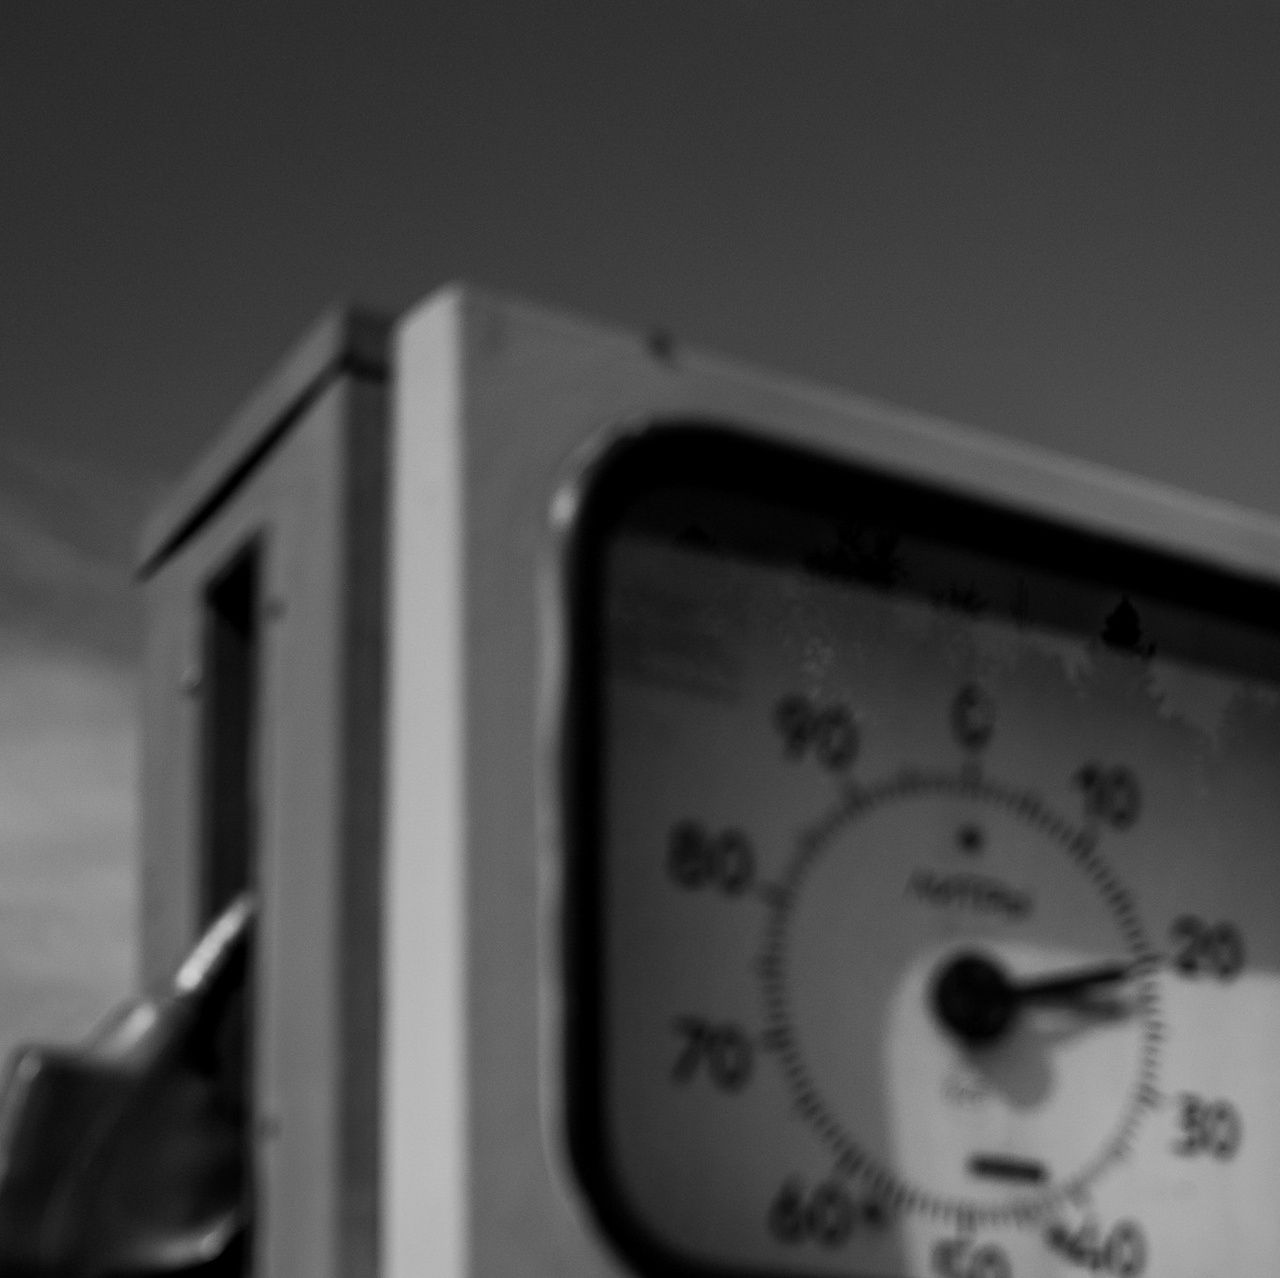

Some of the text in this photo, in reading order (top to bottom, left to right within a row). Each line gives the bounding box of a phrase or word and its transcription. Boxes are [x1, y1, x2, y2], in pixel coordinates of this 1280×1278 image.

[774, 692, 859, 773] 90
[1075, 762, 1142, 830] 10
[668, 820, 754, 897] 80
[1168, 914, 1246, 983] 20
[671, 1014, 754, 1094] 70
[1172, 1092, 1242, 1162] 30
[769, 1178, 856, 1249] 60
